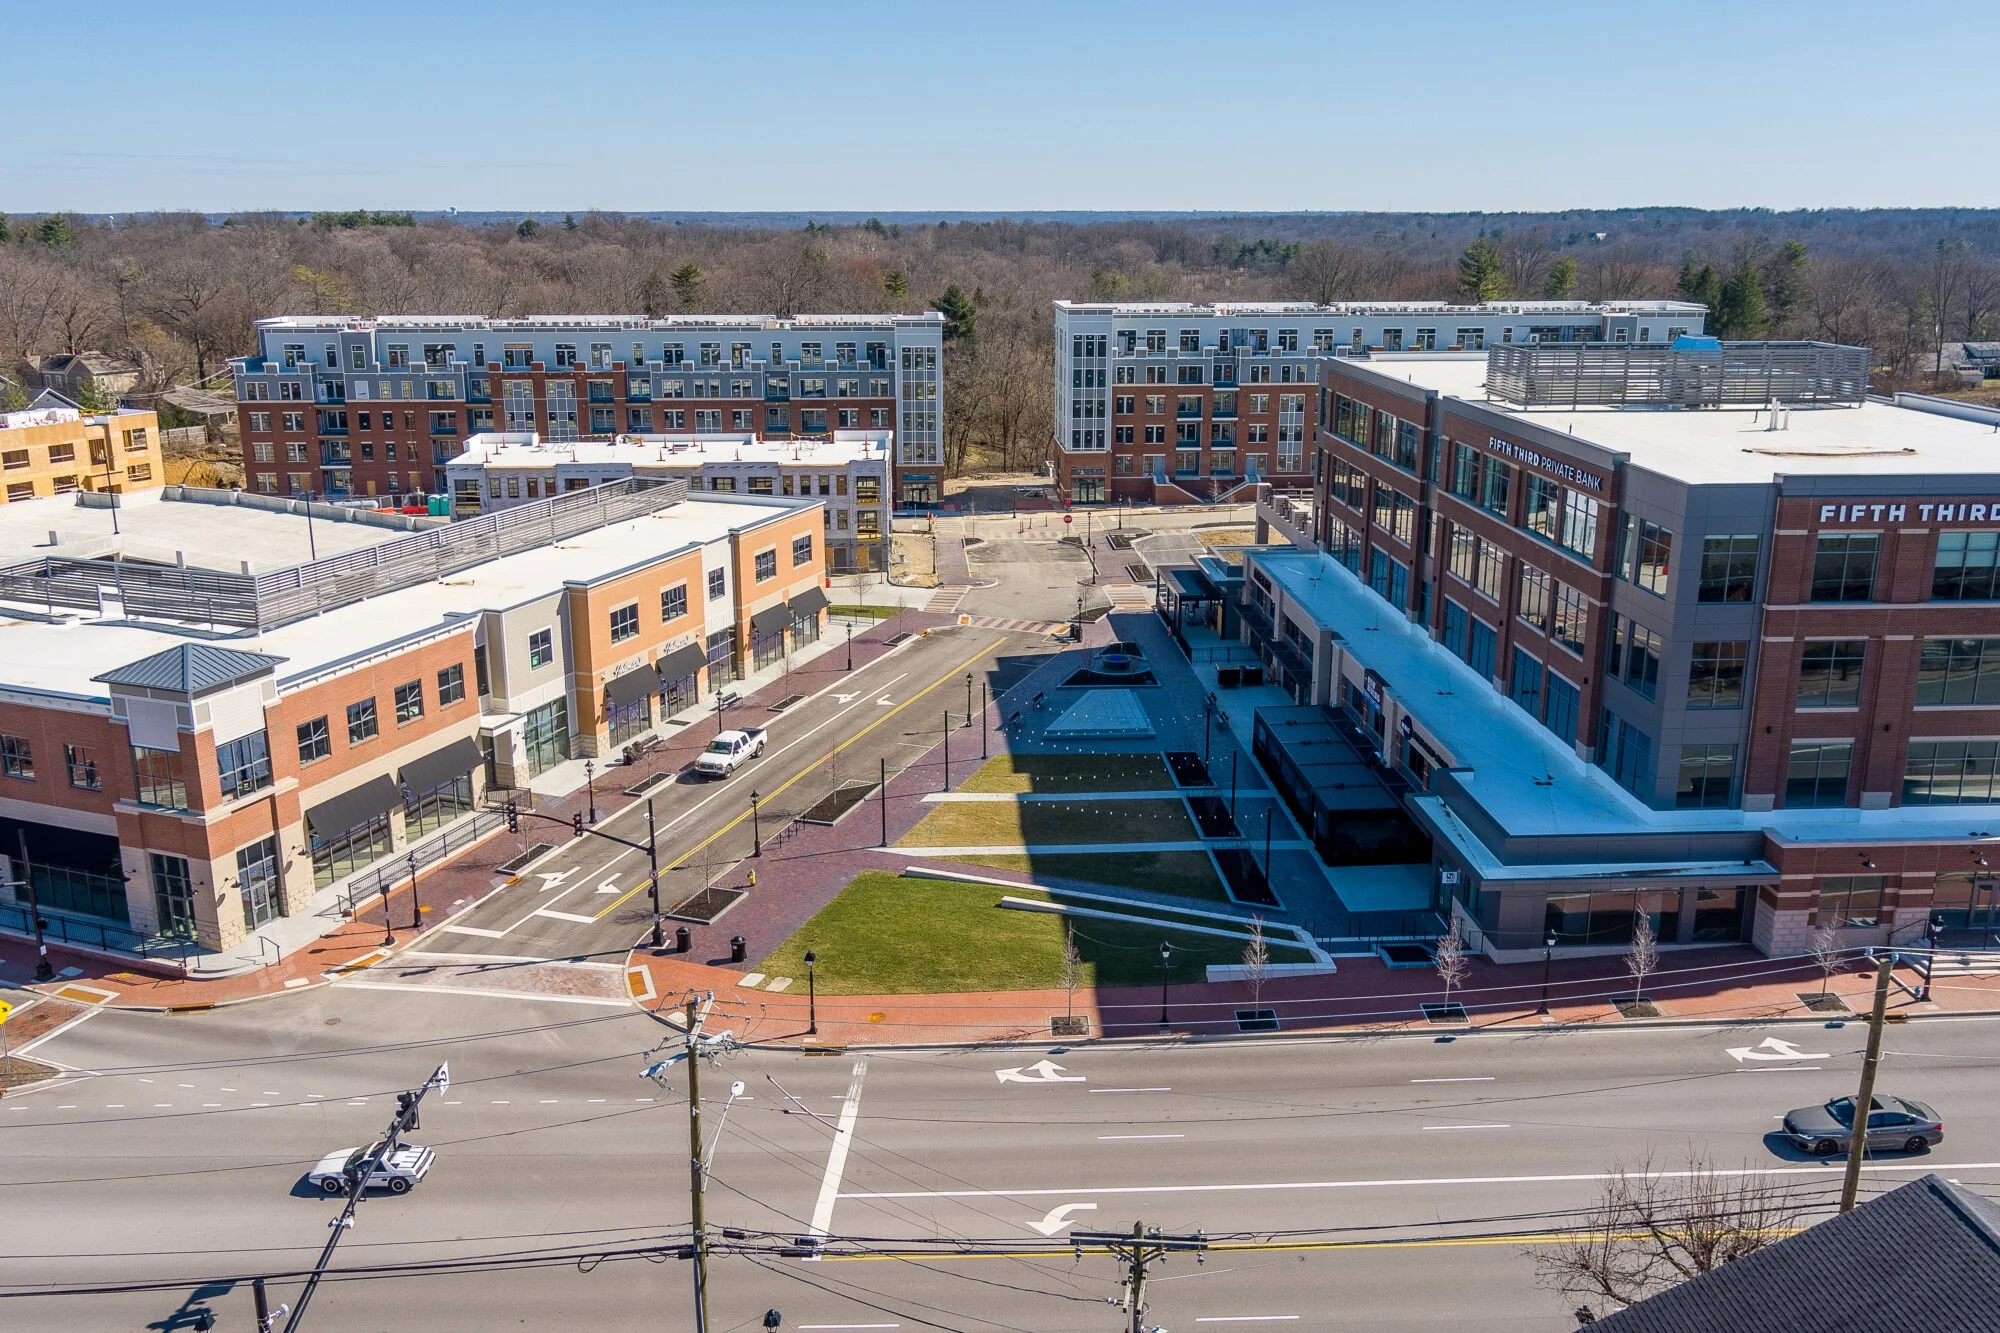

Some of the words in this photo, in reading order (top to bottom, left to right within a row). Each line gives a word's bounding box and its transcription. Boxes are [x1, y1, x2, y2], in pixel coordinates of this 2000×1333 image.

[1489, 436, 1512, 456] FIFTH
[1514, 446, 1540, 467] THIRD
[1541, 456, 1574, 481] PRIVATE
[1576, 469, 1601, 491] BANK
[1820, 504, 1906, 523] FIFTH
[1919, 503, 2000, 522] THIRD
